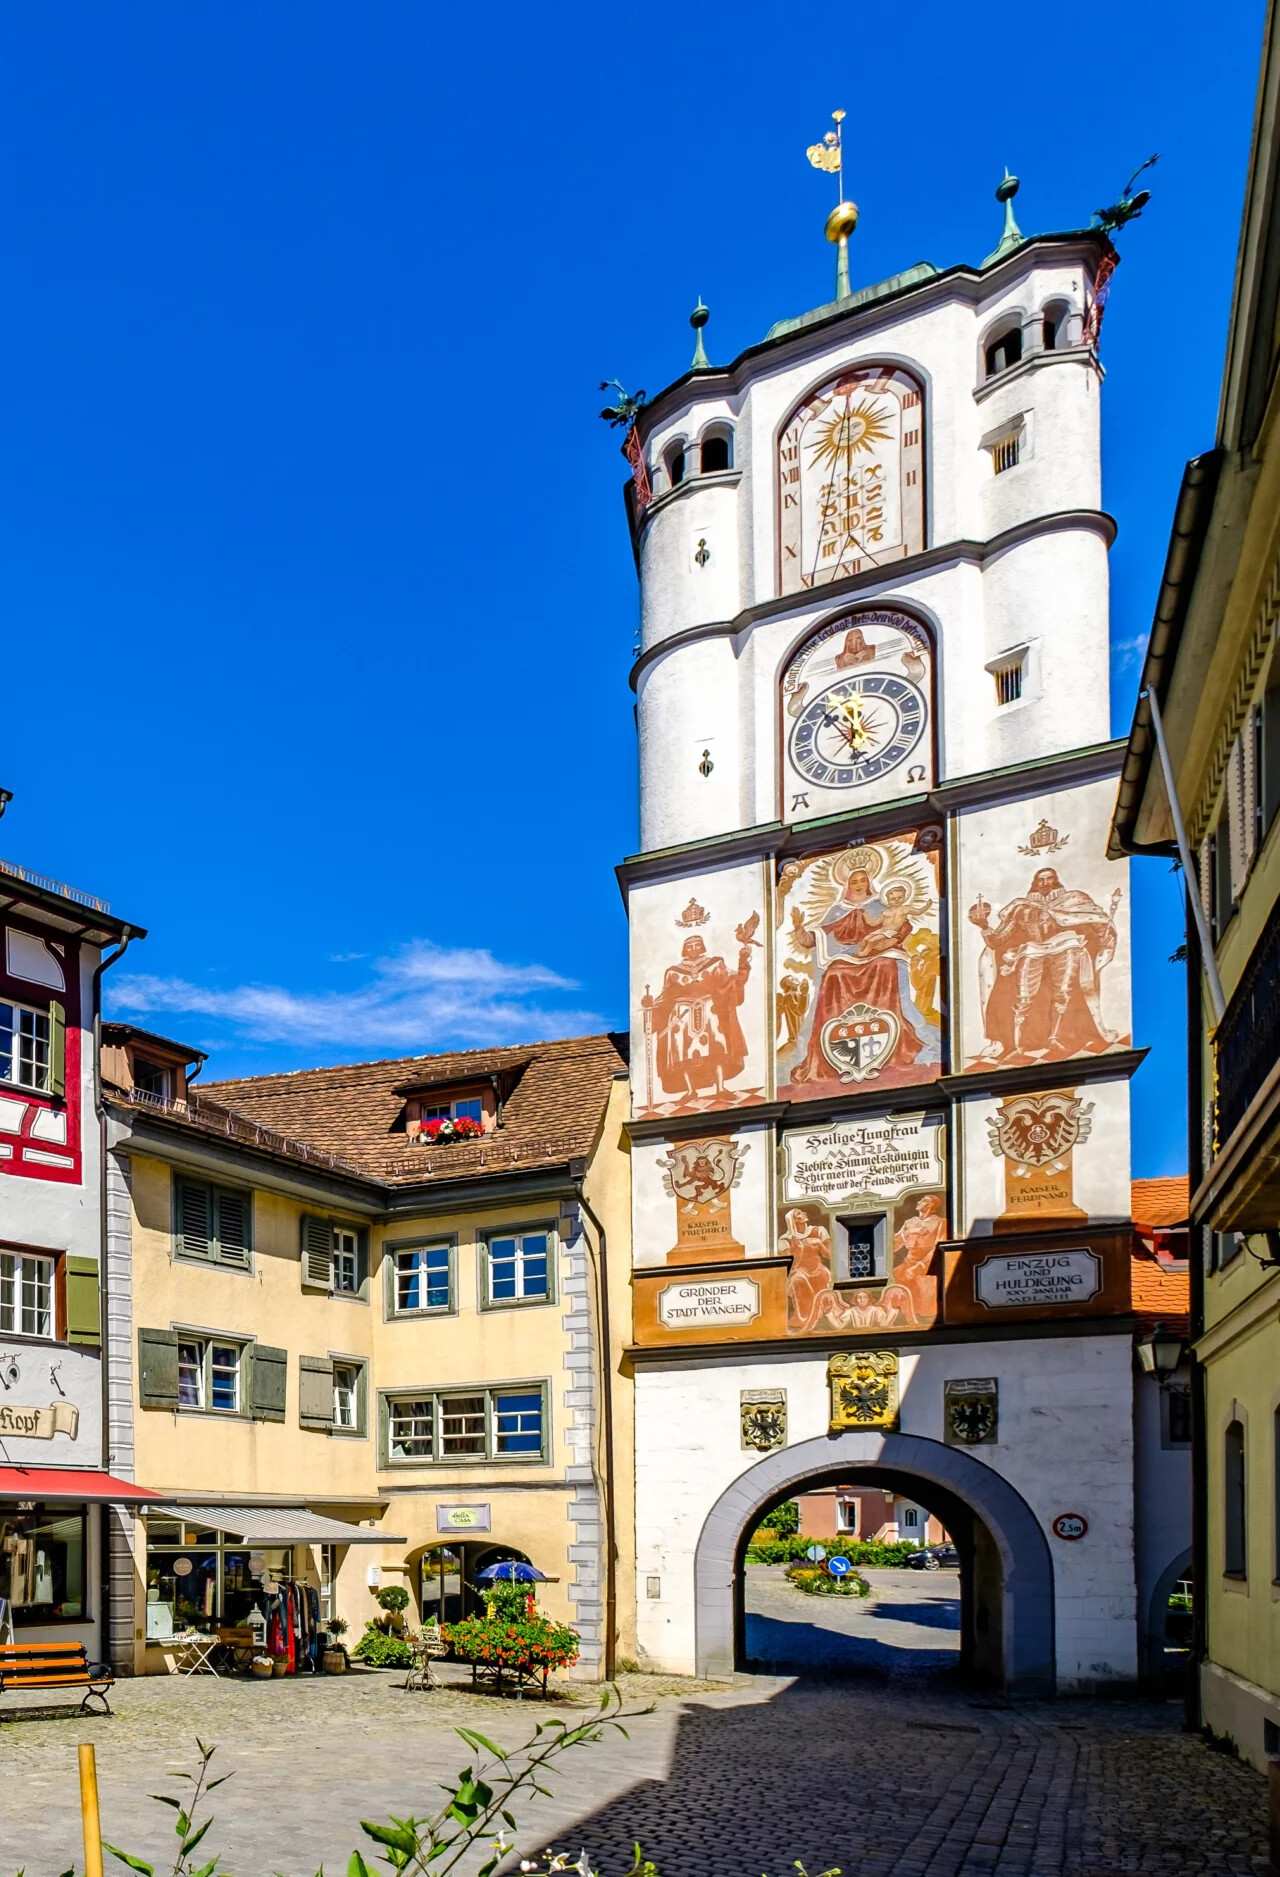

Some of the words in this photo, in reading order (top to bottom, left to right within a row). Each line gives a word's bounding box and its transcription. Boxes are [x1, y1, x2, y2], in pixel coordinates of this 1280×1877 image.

[806, 1132, 855, 1154] Heilige
[855, 1125, 919, 1145] Jungfrau
[826, 1143, 899, 1159] MARIA
[835, 1150, 929, 1169] Himmelskönigin
[794, 1169, 856, 1184] Schirmerin
[1020, 1184, 1060, 1194] KAISER
[1010, 1191, 1069, 1203] FERDINAND
[687, 1220, 719, 1229] KAISER
[1007, 1256, 1071, 1271] EINZUG
[1023, 1268, 1051, 1277] UND
[996, 1274, 1084, 1290] HULDIGUNG
[679, 1285, 738, 1298] GRÜNDER
[1031, 1286, 1073, 1295] JANUAR
[697, 1297, 723, 1306] DER
[667, 1307, 698, 1319] STADT
[701, 1303, 752, 1316] WANGEN
[0, 1406, 41, 1435] Kopf
